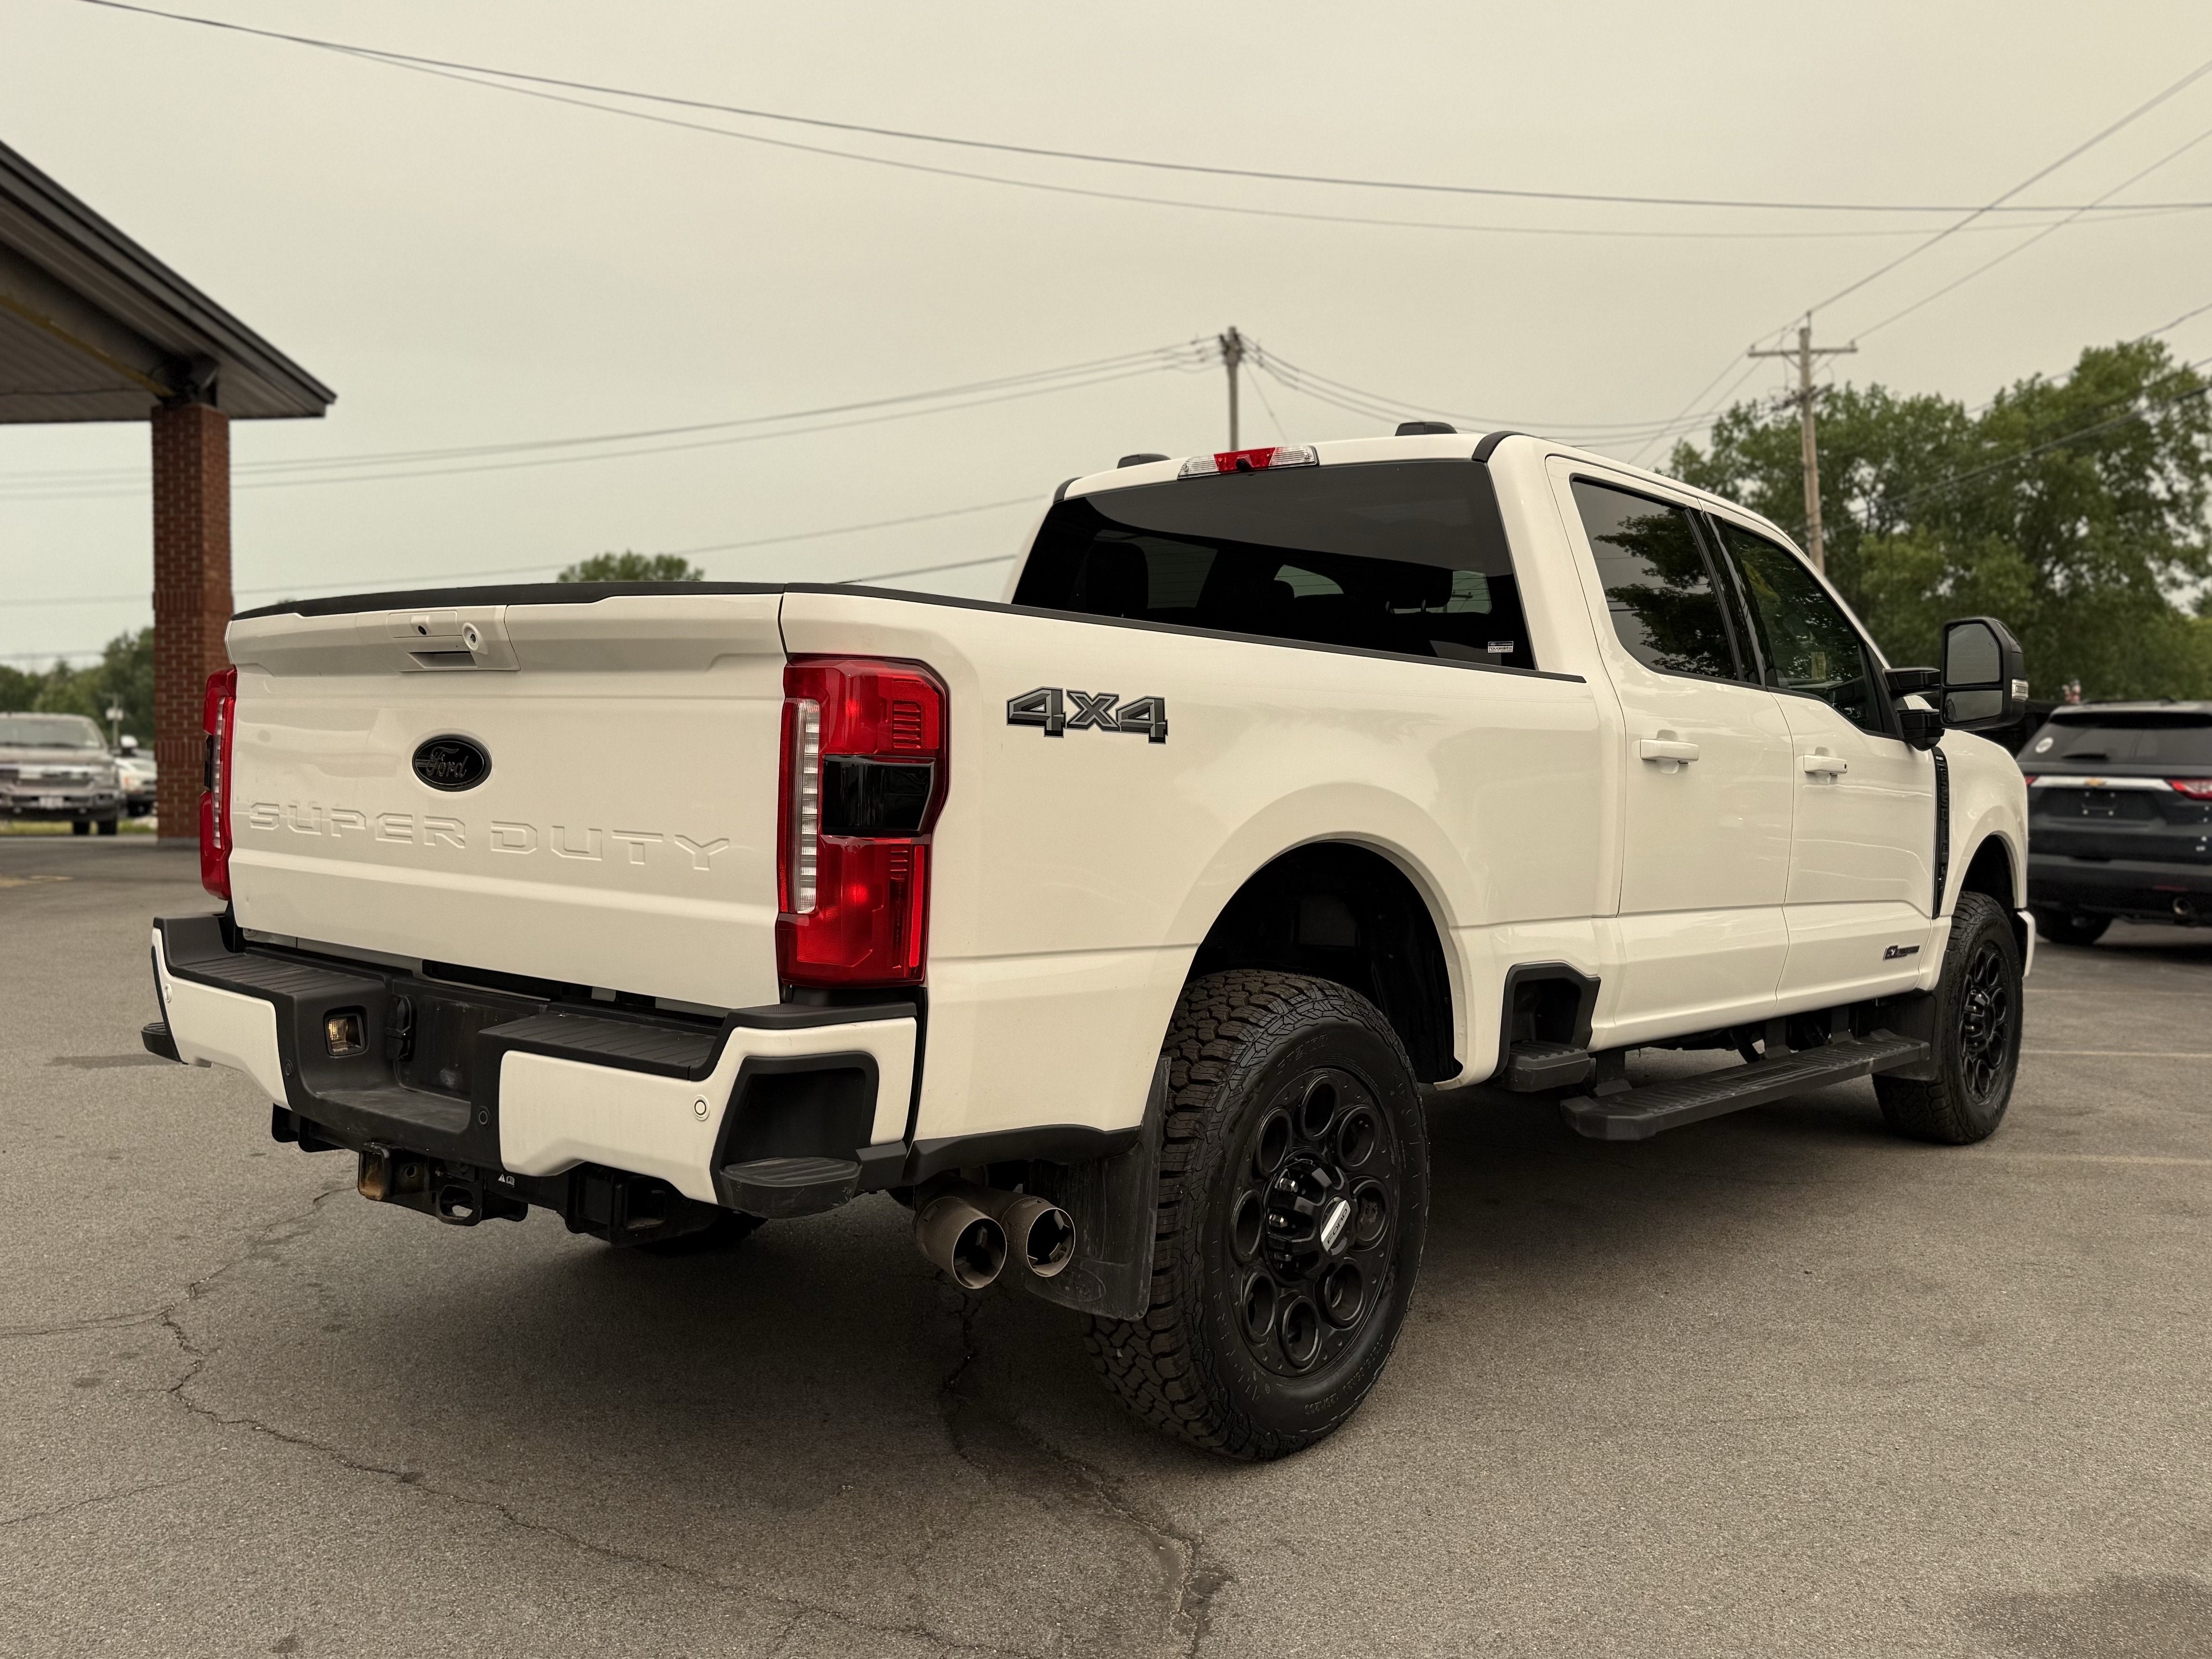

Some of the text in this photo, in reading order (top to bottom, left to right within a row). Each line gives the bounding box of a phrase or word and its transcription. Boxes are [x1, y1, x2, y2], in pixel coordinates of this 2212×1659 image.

[426, 746, 469, 778] Ford
[249, 803, 730, 871] SUPER DUTY
[1327, 1209, 1347, 1244] FORD
